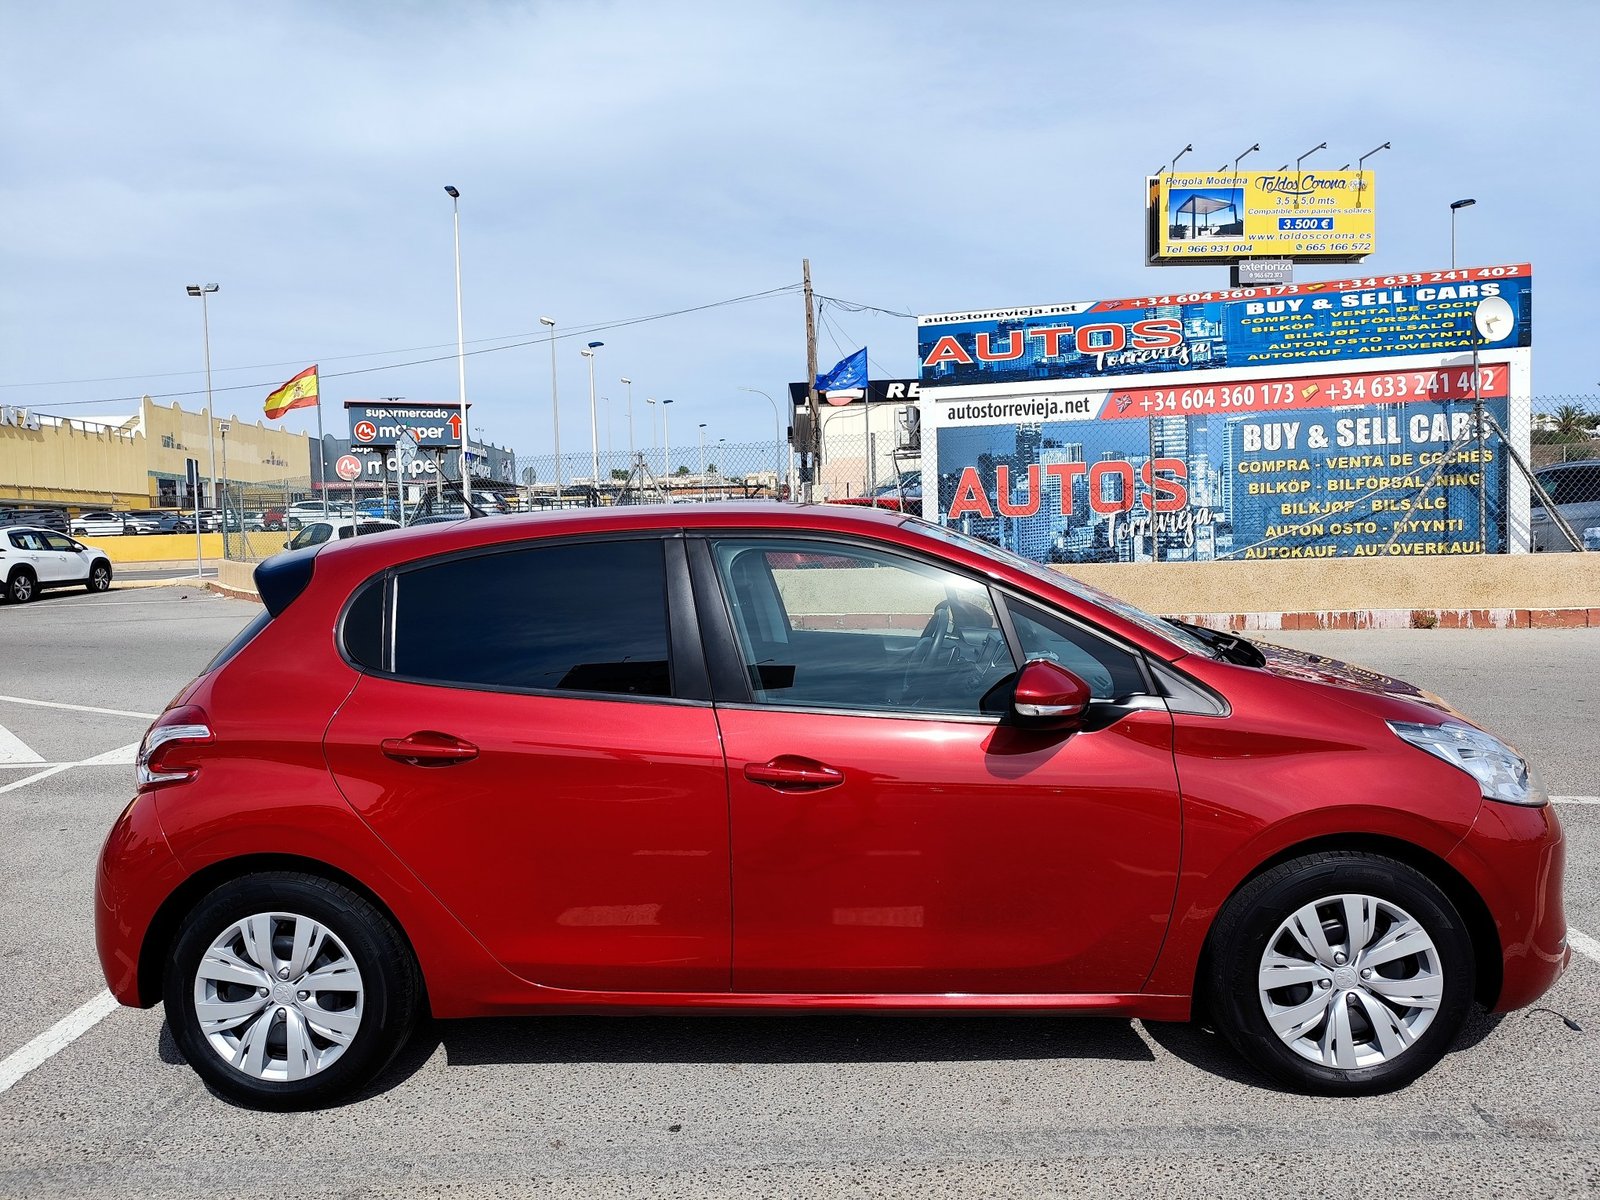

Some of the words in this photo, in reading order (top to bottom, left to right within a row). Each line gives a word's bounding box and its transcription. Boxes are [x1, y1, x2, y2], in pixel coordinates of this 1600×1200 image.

[1206, 177, 1248, 185] Moderna
[1255, 175, 1298, 194] Toldos
[1301, 175, 1347, 190] Corona
[1276, 197, 1290, 206] 3,5
[1301, 197, 1315, 206] 5,0
[1283, 219, 1318, 229] 3.500
[1321, 219, 1330, 229] €
[1248, 233, 1372, 241] www.toldoscorona.es
[1306, 243, 1326, 251] 665
[1330, 243, 1348, 251] 166
[1351, 242, 1371, 251] 572
[1187, 244, 1207, 253] 966
[1210, 244, 1230, 253] 931
[1232, 244, 1253, 252] 004
[1239, 262, 1292, 271] exterioriza
[1332, 277, 1376, 290] +34
[1383, 274, 1422, 286] 633
[1430, 270, 1468, 282] 241
[1477, 266, 1519, 277] 402
[1131, 296, 1171, 307] +34
[1176, 292, 1213, 304] 604
[1219, 289, 1256, 300] 360
[1262, 285, 1299, 296] 173
[1246, 299, 1304, 315] BUY
[1312, 299, 1333, 310] &
[1341, 289, 1407, 307] SELL
[1416, 282, 1500, 301] CARS
[924, 304, 1077, 323] autostorrevieja.net
[1241, 313, 1313, 325] COMPRA
[1330, 308, 1389, 318] VENTA
[1396, 305, 1419, 313] DE
[1426, 301, 1478, 310] COCH
[1252, 322, 1315, 333] BILKÖP
[1331, 311, 1474, 327] BILFÖRSÄLJNIN
[1269, 340, 1328, 350] AUTON
[1334, 336, 1382, 345] OSTO
[1400, 330, 1471, 341] MYYNTI
[1285, 329, 1359, 340] BILKJØP
[1377, 321, 1455, 333] BILSALG
[922, 318, 1183, 367] AUTOS
[1089, 341, 1210, 371] Torrevieja
[1248, 348, 1341, 360] AUTOKAUF
[1325, 378, 1366, 401] +34
[1371, 376, 1408, 398] 633
[1414, 372, 1450, 395] 241
[1457, 369, 1495, 392] 402
[1139, 391, 1177, 412] +34
[1181, 388, 1215, 409] 604
[1220, 385, 1255, 407] 360
[1261, 383, 1295, 405] 173
[365, 408, 448, 420] supermercado
[947, 396, 1090, 421] autostorrevieja.net
[379, 424, 445, 440] maper
[1243, 421, 1300, 452] BUY
[1307, 424, 1329, 448] &
[1336, 416, 1402, 446] SELL
[1409, 411, 1491, 444] CARS
[1238, 458, 1310, 474] COMPRA
[1326, 455, 1384, 469] VENTA
[1390, 453, 1413, 467] DE
[948, 458, 1188, 519] AUTOS
[1249, 478, 1311, 495] BILKÖP
[1372, 497, 1447, 512] BILSALG
[1103, 506, 1214, 549] Torrevieja
[1265, 523, 1324, 537] AUTON
[1330, 521, 1377, 535] OSTO
[1394, 519, 1463, 533] MYYNTI
[1245, 545, 1338, 559] AUTOKAUF
